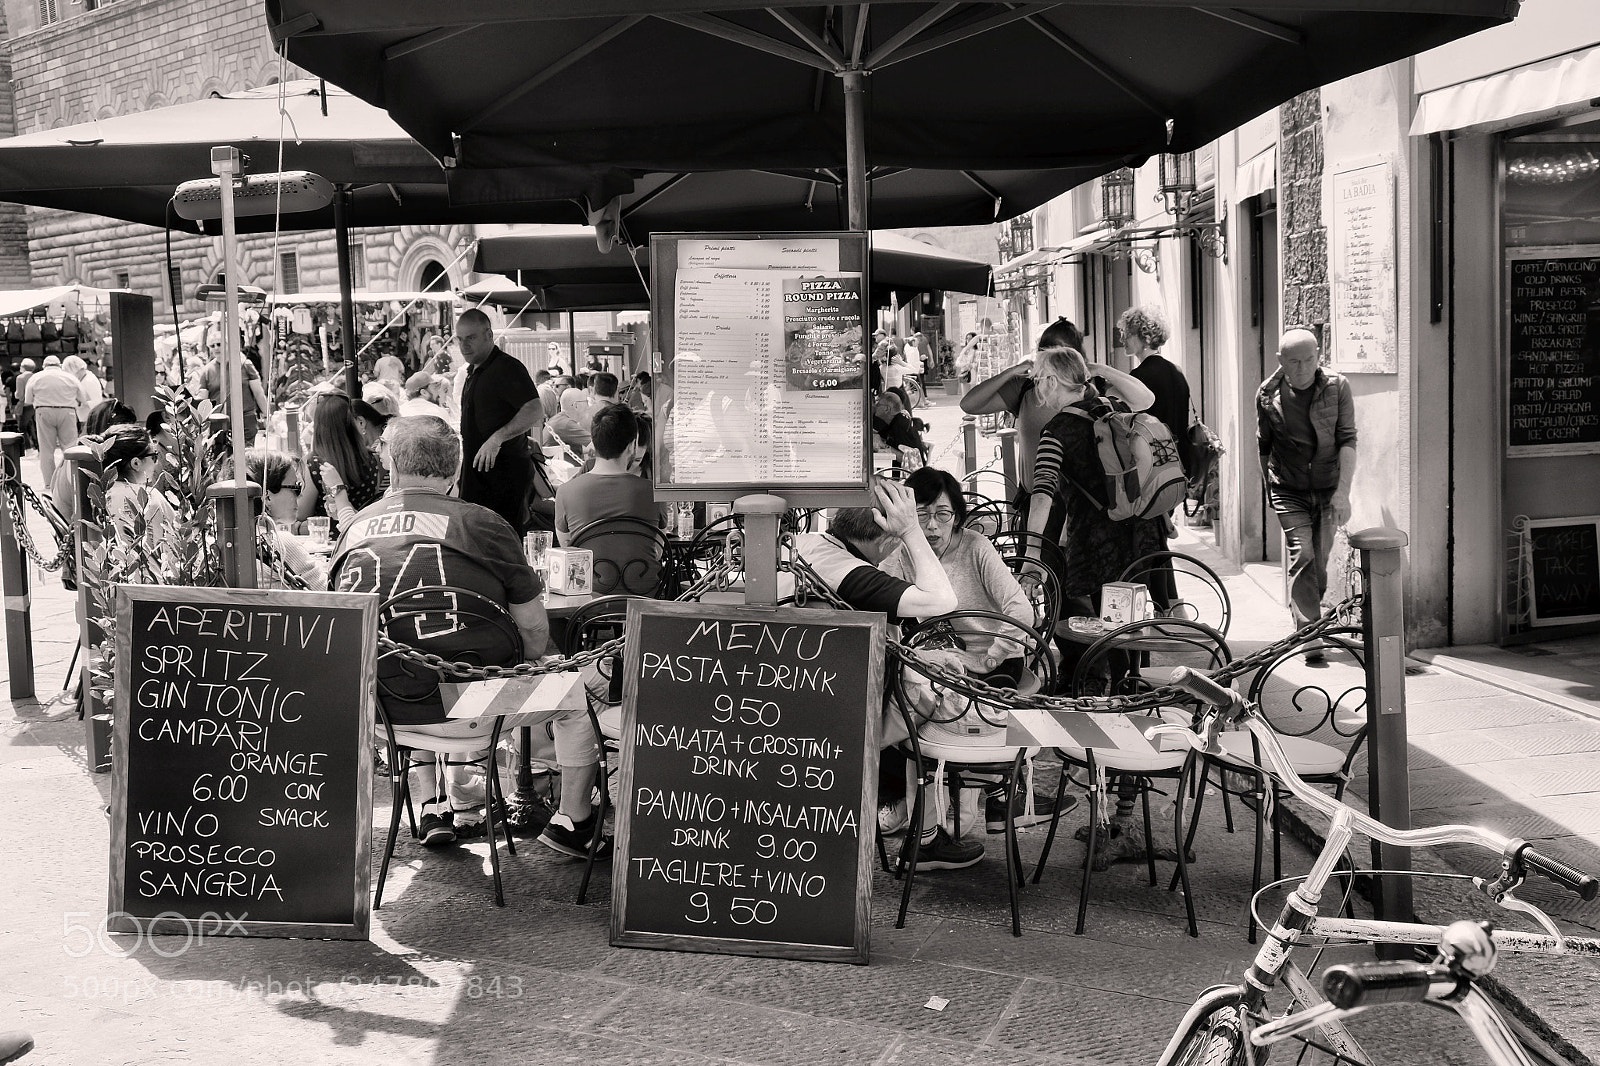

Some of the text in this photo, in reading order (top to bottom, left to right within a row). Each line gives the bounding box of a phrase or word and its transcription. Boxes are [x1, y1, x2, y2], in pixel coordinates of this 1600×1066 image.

[1343, 183, 1377, 200] LA BADIA
[801, 281, 841, 291] PIZZA
[1517, 286, 1587, 297] ITALIAN BEER
[1524, 274, 1582, 285] COLD DRINKS
[784, 291, 859, 302] ROUND PIZZA
[1529, 300, 1577, 311] PROSECCO
[806, 306, 840, 314] Margherita
[1521, 324, 1587, 336] APEROL SPRITZ
[1531, 337, 1585, 349] BREAKFAST
[1529, 363, 1584, 374] HOT PIZZA
[1514, 377, 1544, 388] PIATTO
[1558, 377, 1592, 388] SALUMI
[1527, 389, 1582, 401] MIX SALAD
[1528, 426, 1580, 441] ICE CREAM
[364, 513, 417, 537] READ
[1540, 554, 1589, 576] TAKE
[1540, 583, 1592, 603] AWAY
[147, 605, 336, 654] APERITIVI
[686, 621, 839, 661] MENU
[141, 645, 272, 681] SPRITZ
[641, 652, 728, 687] PASTA
[756, 663, 838, 697] DRINK
[137, 679, 305, 723] GIN TONIC
[711, 694, 782, 728] 9.50
[138, 718, 268, 753] CAMPARI
[635, 723, 727, 755] INSALATA
[229, 750, 329, 776] ORANGE
[691, 755, 836, 792] DRINK 9.50
[192, 772, 326, 803] 6.00 CON
[138, 805, 331, 838] VINO SNACK
[636, 787, 727, 824] PANINO
[743, 799, 859, 838] INSALATINA
[131, 840, 277, 868] PROSECCO
[671, 827, 818, 863] DRINK 9.00
[138, 869, 284, 902] SANGRIA
[631, 857, 747, 889] TAGLIERE
[767, 869, 827, 899] VINO
